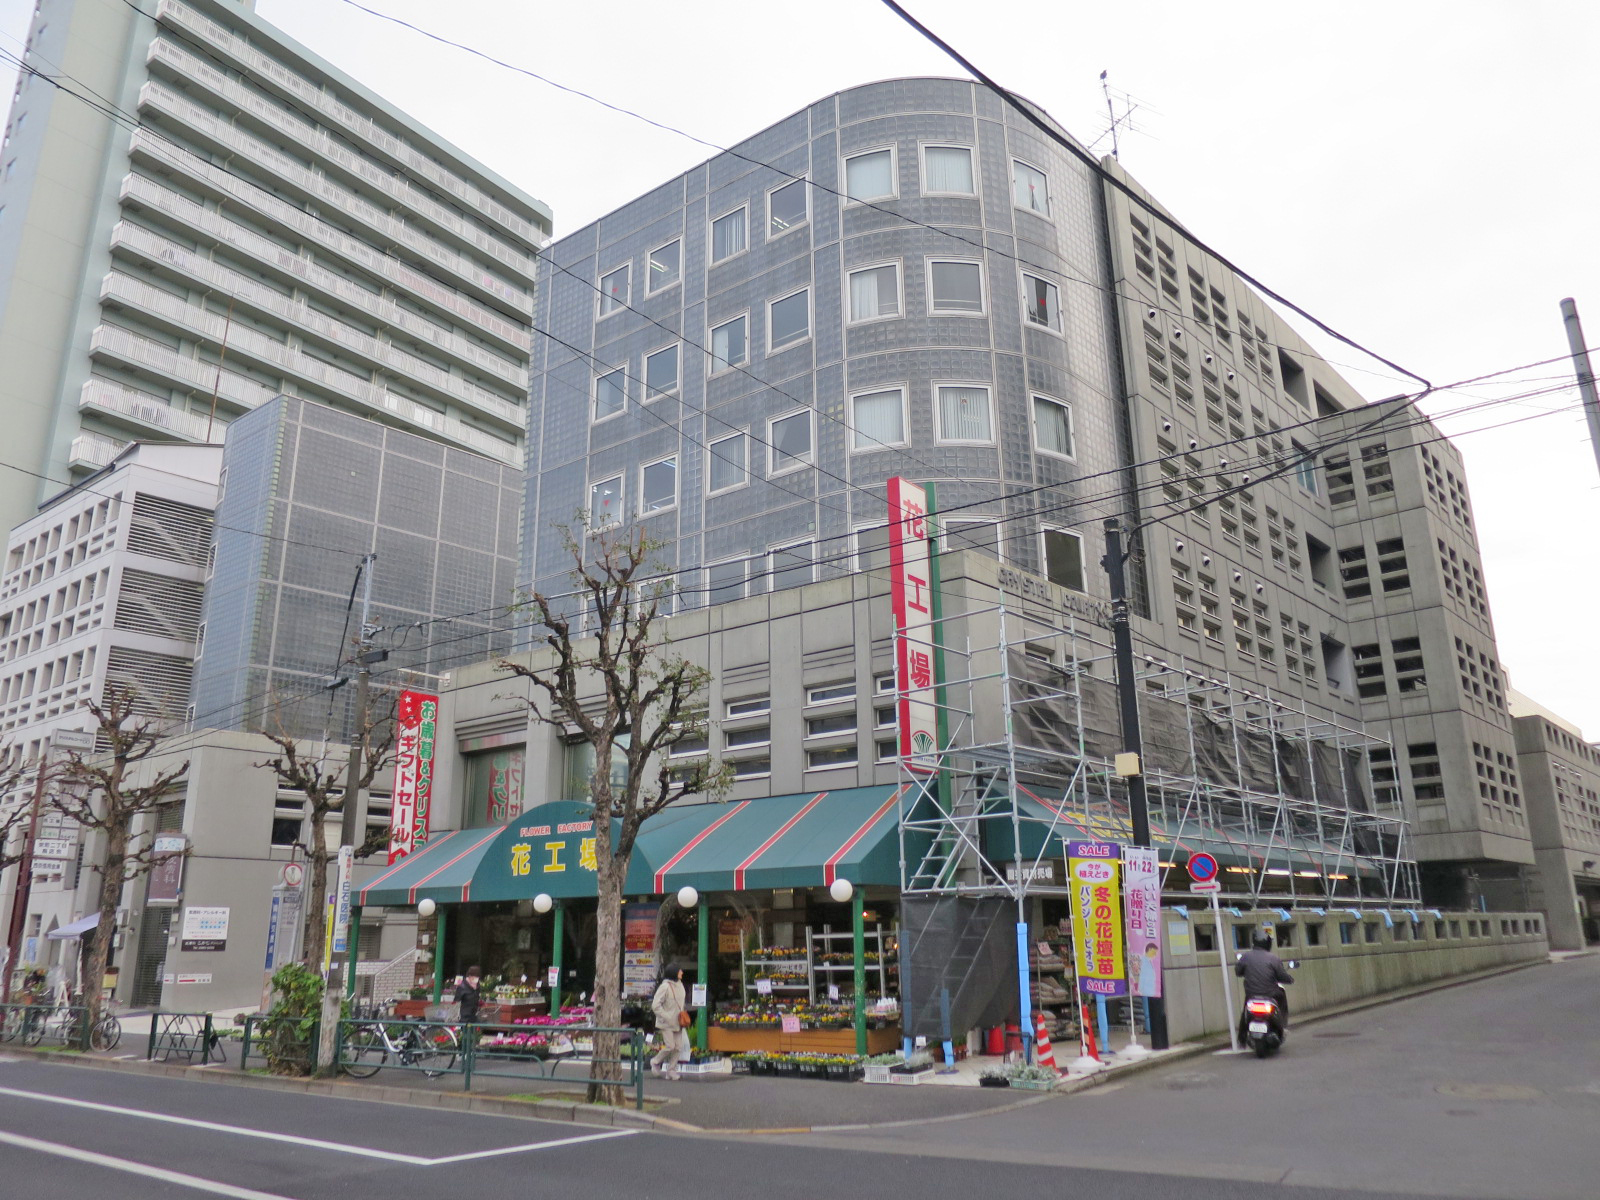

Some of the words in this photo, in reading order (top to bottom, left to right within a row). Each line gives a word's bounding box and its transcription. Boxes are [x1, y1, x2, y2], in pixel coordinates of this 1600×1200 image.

[903, 498, 930, 692] 花工場
[998, 567, 1053, 602] CRYSTAL
[396, 735, 416, 843] ギフトセール
[520, 826, 551, 837] FLOWER
[557, 821, 593, 834] FACTORY
[511, 838, 598, 876] 花工場
[1078, 845, 1109, 856] SALE
[1079, 870, 1109, 878] 植えどき
[340, 881, 349, 924] 白石医院
[1130, 889, 1143, 929] 花贈り日
[1094, 886, 1114, 975] 冬の花壇苗
[1086, 981, 1115, 993] SALE
